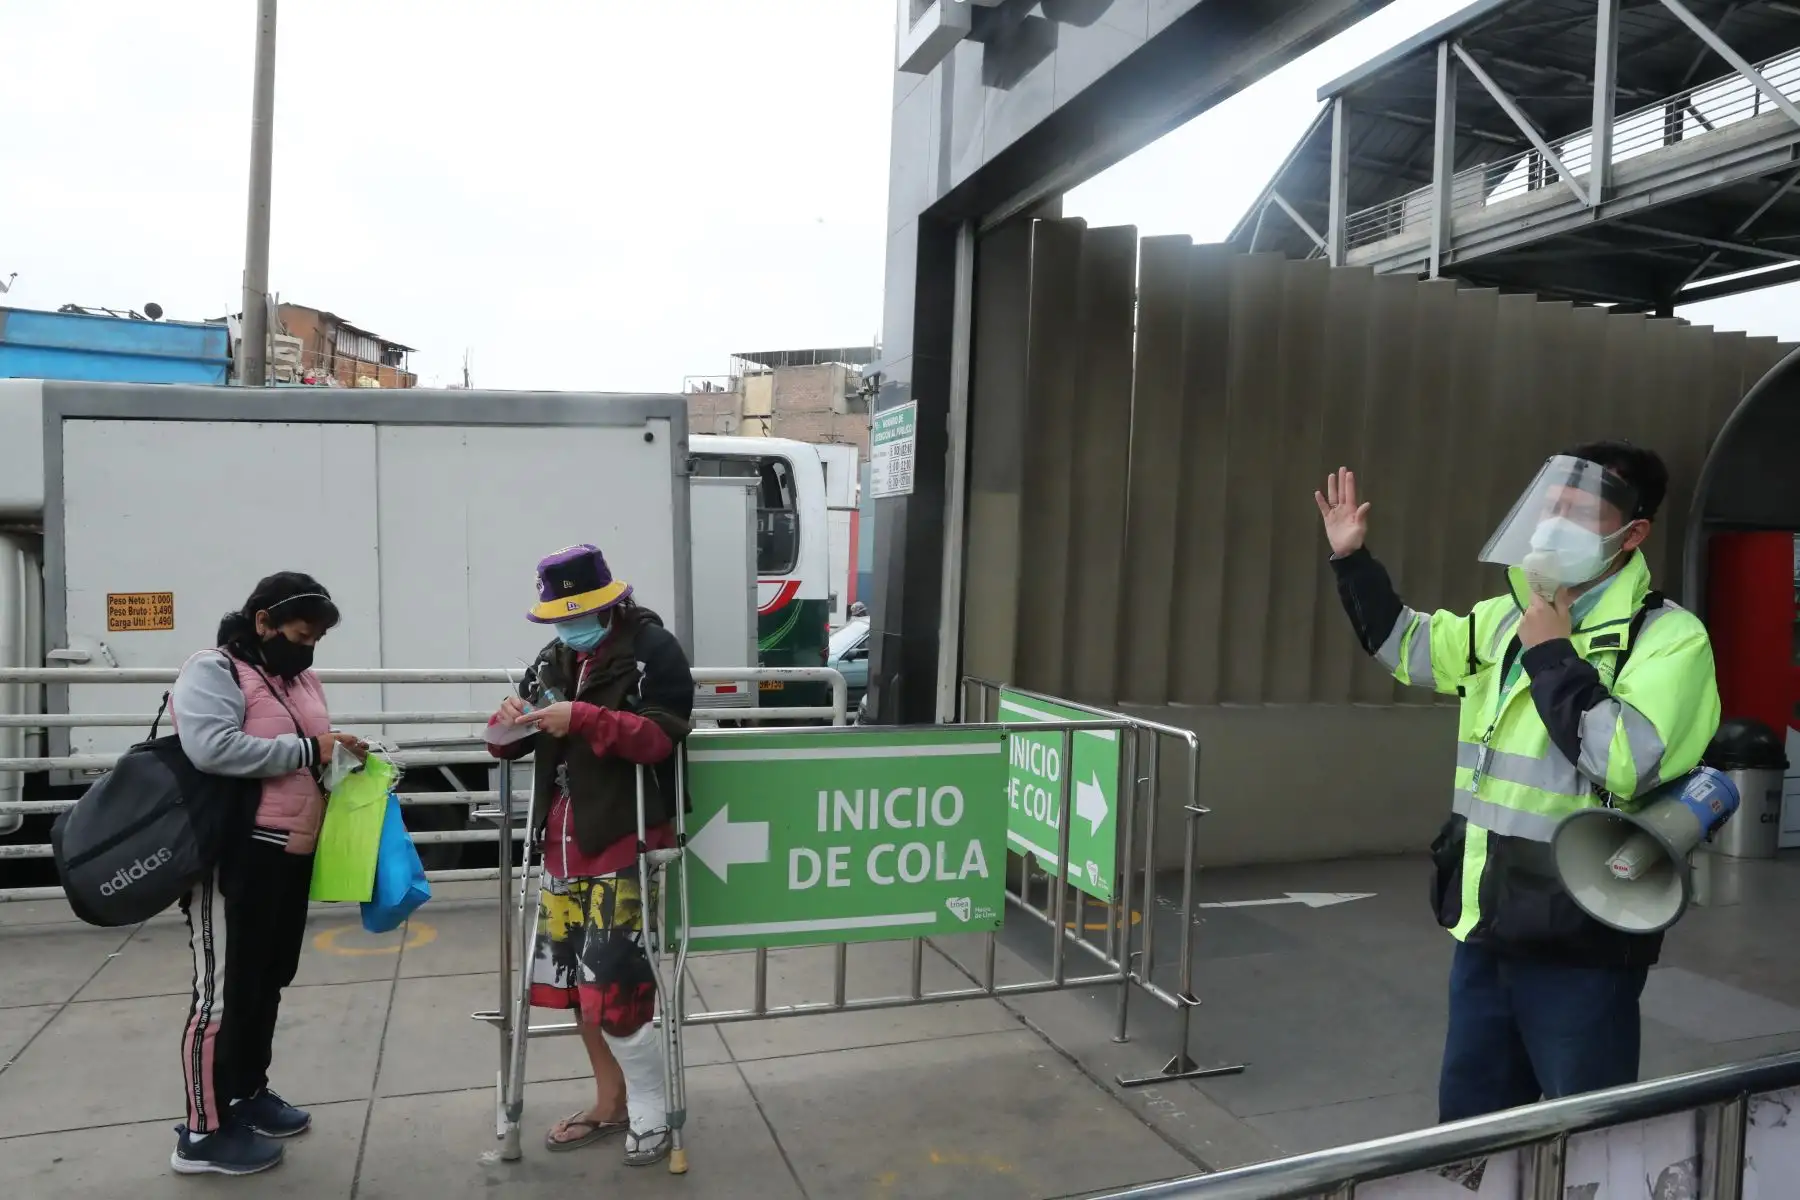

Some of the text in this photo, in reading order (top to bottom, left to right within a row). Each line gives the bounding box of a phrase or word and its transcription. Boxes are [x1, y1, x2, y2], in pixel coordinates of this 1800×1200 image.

[110, 596, 126, 605] Peso
[128, 596, 145, 604] Neto
[110, 607, 126, 616] Peso
[129, 606, 147, 615] Bruto
[110, 618, 131, 628] Carga
[1010, 734, 1059, 782] INICIO
[817, 785, 964, 832] INICIO
[100, 847, 172, 896] adidas
[788, 839, 989, 890] DE COLA
